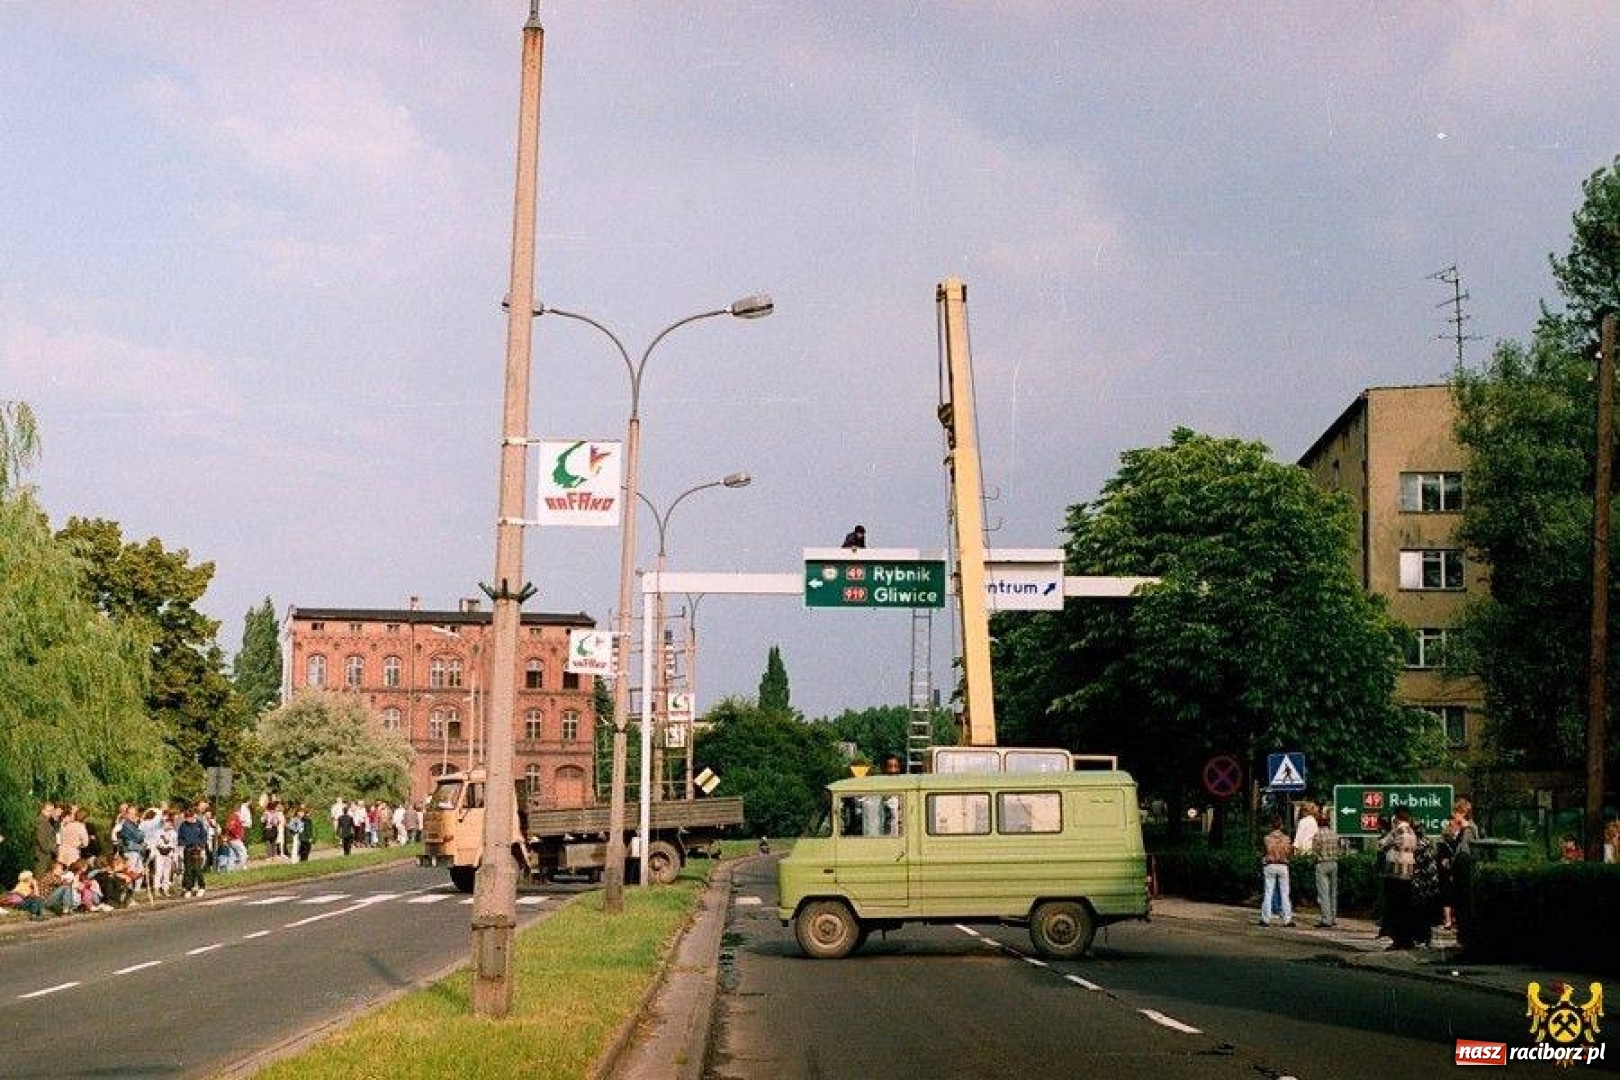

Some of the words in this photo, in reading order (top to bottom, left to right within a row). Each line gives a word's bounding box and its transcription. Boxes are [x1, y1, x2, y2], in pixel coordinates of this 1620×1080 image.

[873, 566, 931, 585] Rybnik
[874, 586, 937, 602] Gliwice
[987, 580, 1038, 595] ntrum
[1364, 793, 1381, 806] 49
